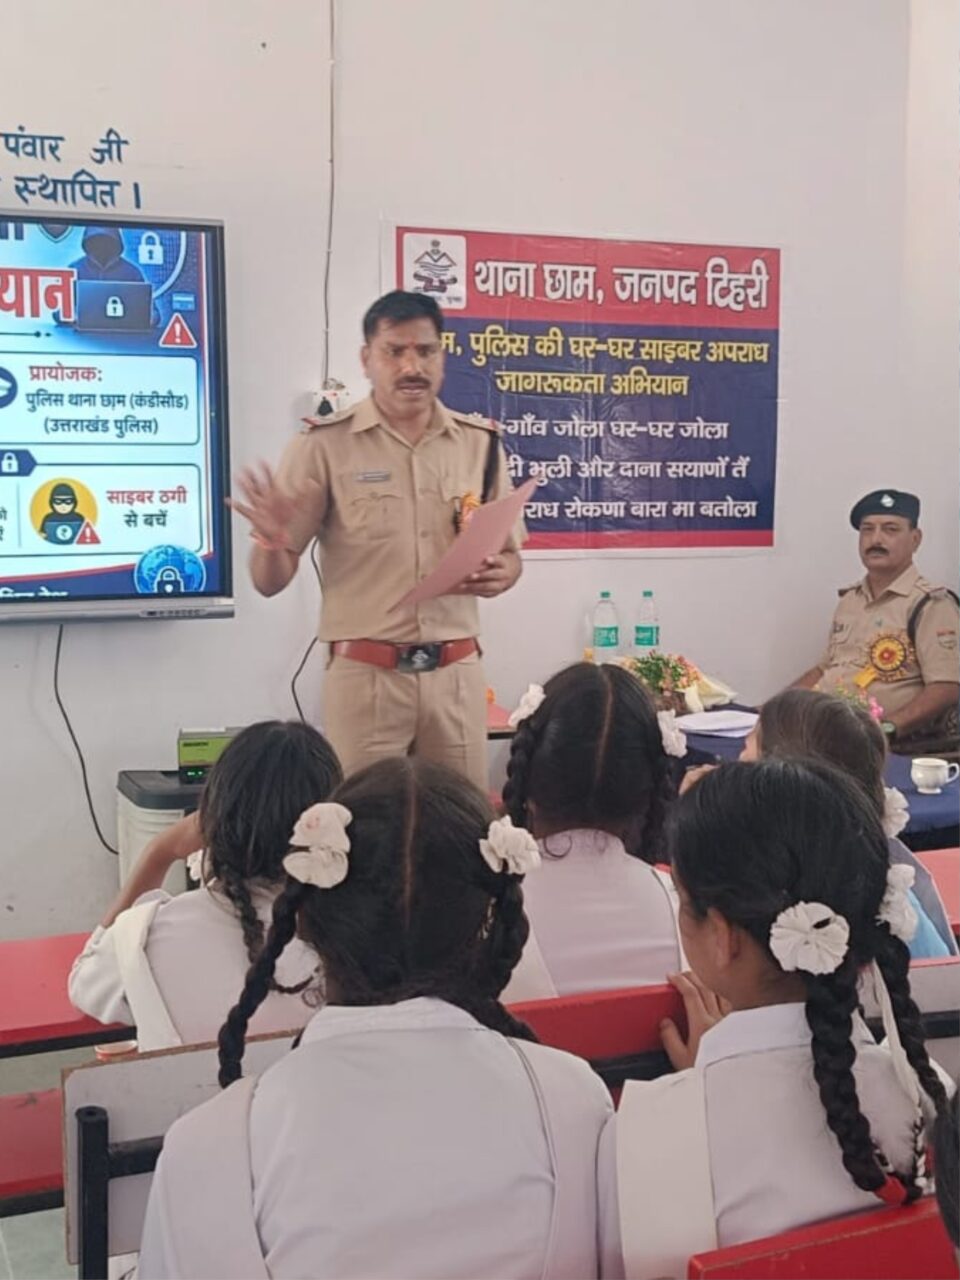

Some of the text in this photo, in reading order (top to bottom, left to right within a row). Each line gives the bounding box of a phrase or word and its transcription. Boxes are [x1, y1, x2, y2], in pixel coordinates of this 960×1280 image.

[0, 125, 129, 165] पंवार जी
[14, 169, 121, 207] स्थापित
[474, 257, 770, 312] थाना छाम, जनपद टिहरी
[469, 324, 529, 365] पुलिस
[535, 327, 563, 357] की
[639, 339, 702, 364] साइबर
[706, 341, 769, 363] अपराध
[29, 362, 103, 382] प्रायोजक:
[496, 366, 690, 396] जागरूकता अभियान
[26, 388, 64, 412] पुलिस
[68, 393, 96, 408] थाना
[44, 415, 159, 439] (उत्तराखंड पुलिस)
[553, 416, 605, 438] जोला
[679, 417, 728, 440] जोला
[529, 454, 572, 486] भुली
[577, 455, 613, 478] और
[619, 460, 661, 478] दाना
[666, 455, 727, 479] सयाणों
[106, 485, 187, 506] साइबर ठगी
[564, 495, 625, 520] रोकणा
[631, 501, 667, 518] बारा
[672, 500, 696, 518] मा
[700, 494, 757, 519] बतोला
[124, 510, 168, 528] से बचें
